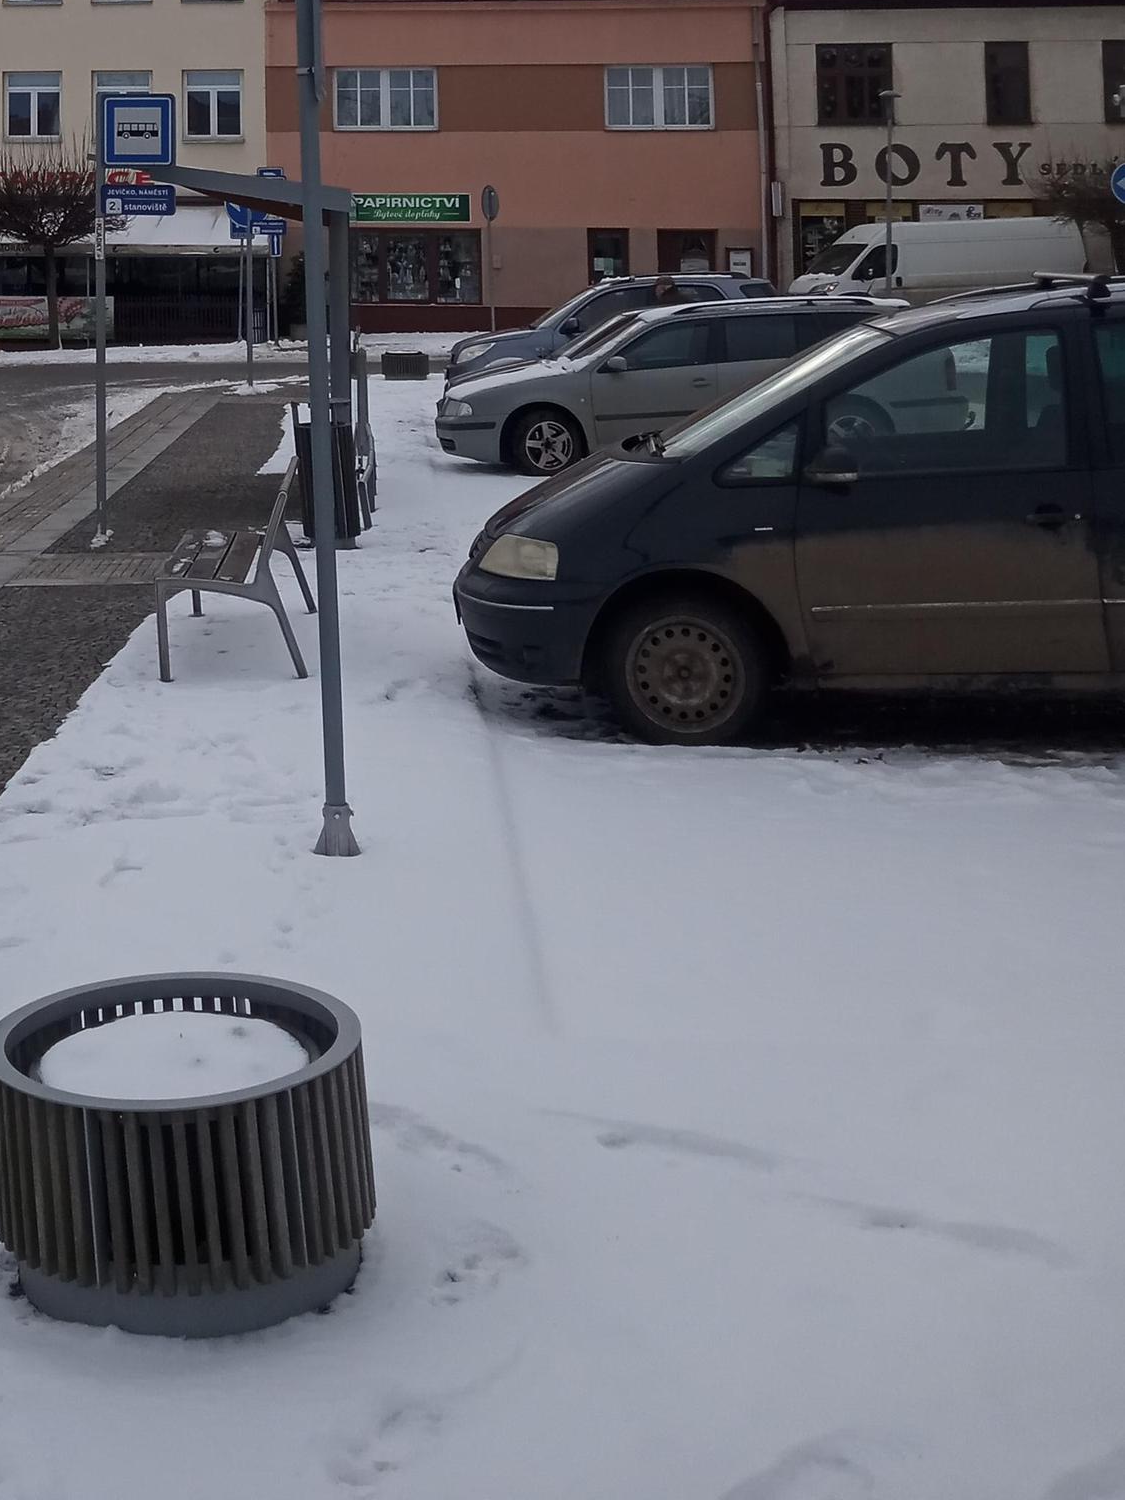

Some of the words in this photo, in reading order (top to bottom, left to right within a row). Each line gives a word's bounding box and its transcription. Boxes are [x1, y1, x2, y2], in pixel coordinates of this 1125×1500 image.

[819, 141, 1032, 187] BOTY
[109, 201, 121, 211] 2.
[124, 203, 167, 211] stanoviště
[353, 194, 460, 208] PAPÍRNICTVÍ
